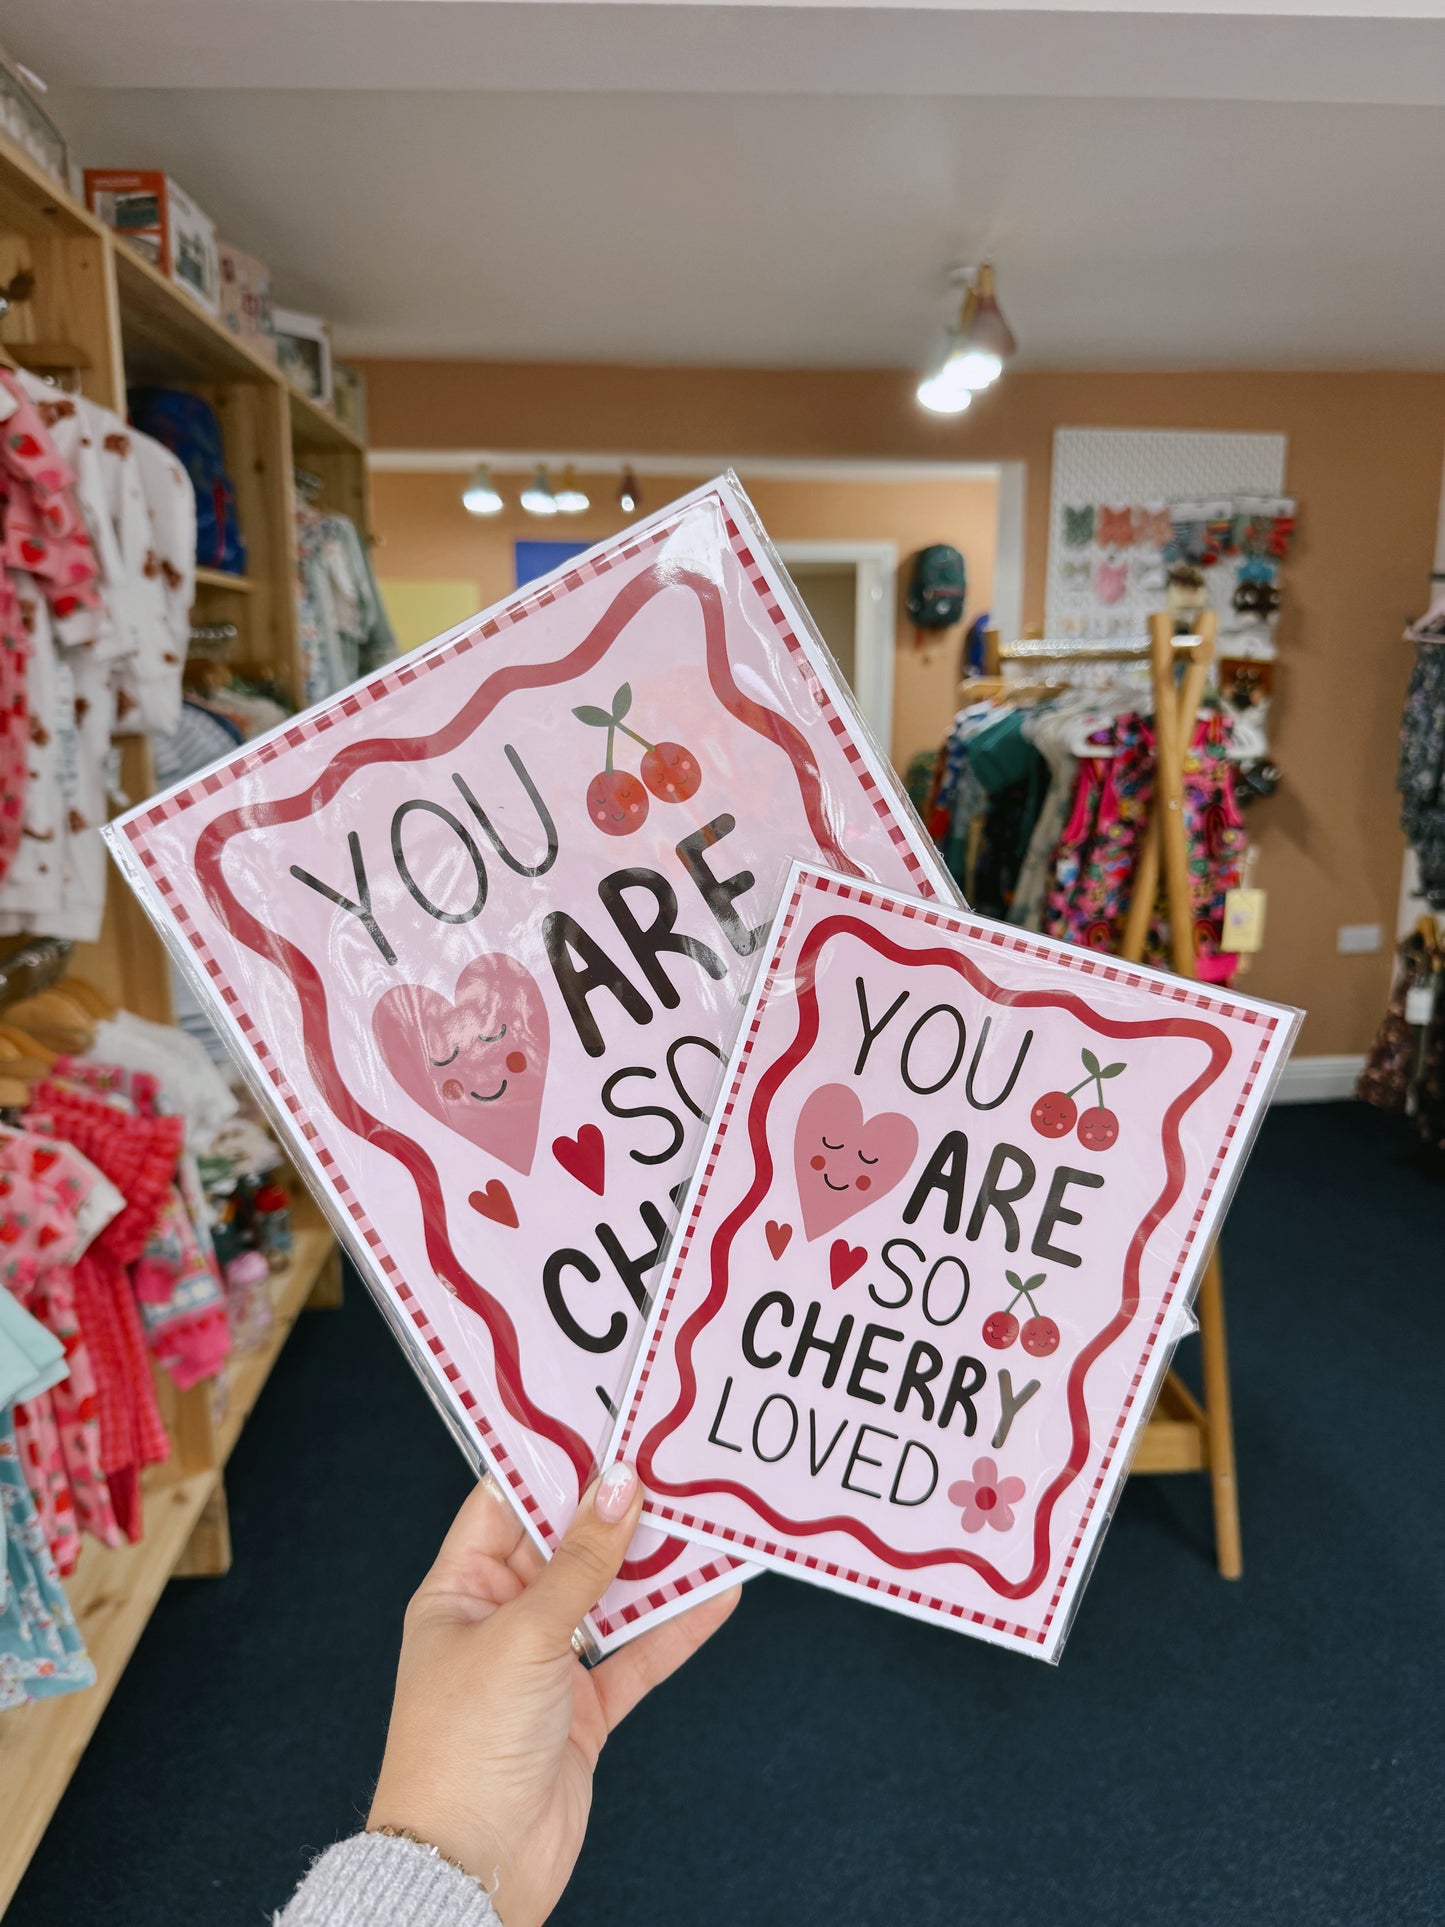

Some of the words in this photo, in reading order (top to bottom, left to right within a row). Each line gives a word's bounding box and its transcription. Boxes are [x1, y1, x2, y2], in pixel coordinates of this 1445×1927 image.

[290, 744, 559, 966] YOU
[542, 813, 772, 1058] ARE
[853, 976, 1034, 1111] YOU
[902, 1130, 1105, 1269] ARE
[867, 1238, 970, 1327] SO
[741, 1290, 1042, 1449] CHERRY
[707, 1376, 939, 1507] LOVED
